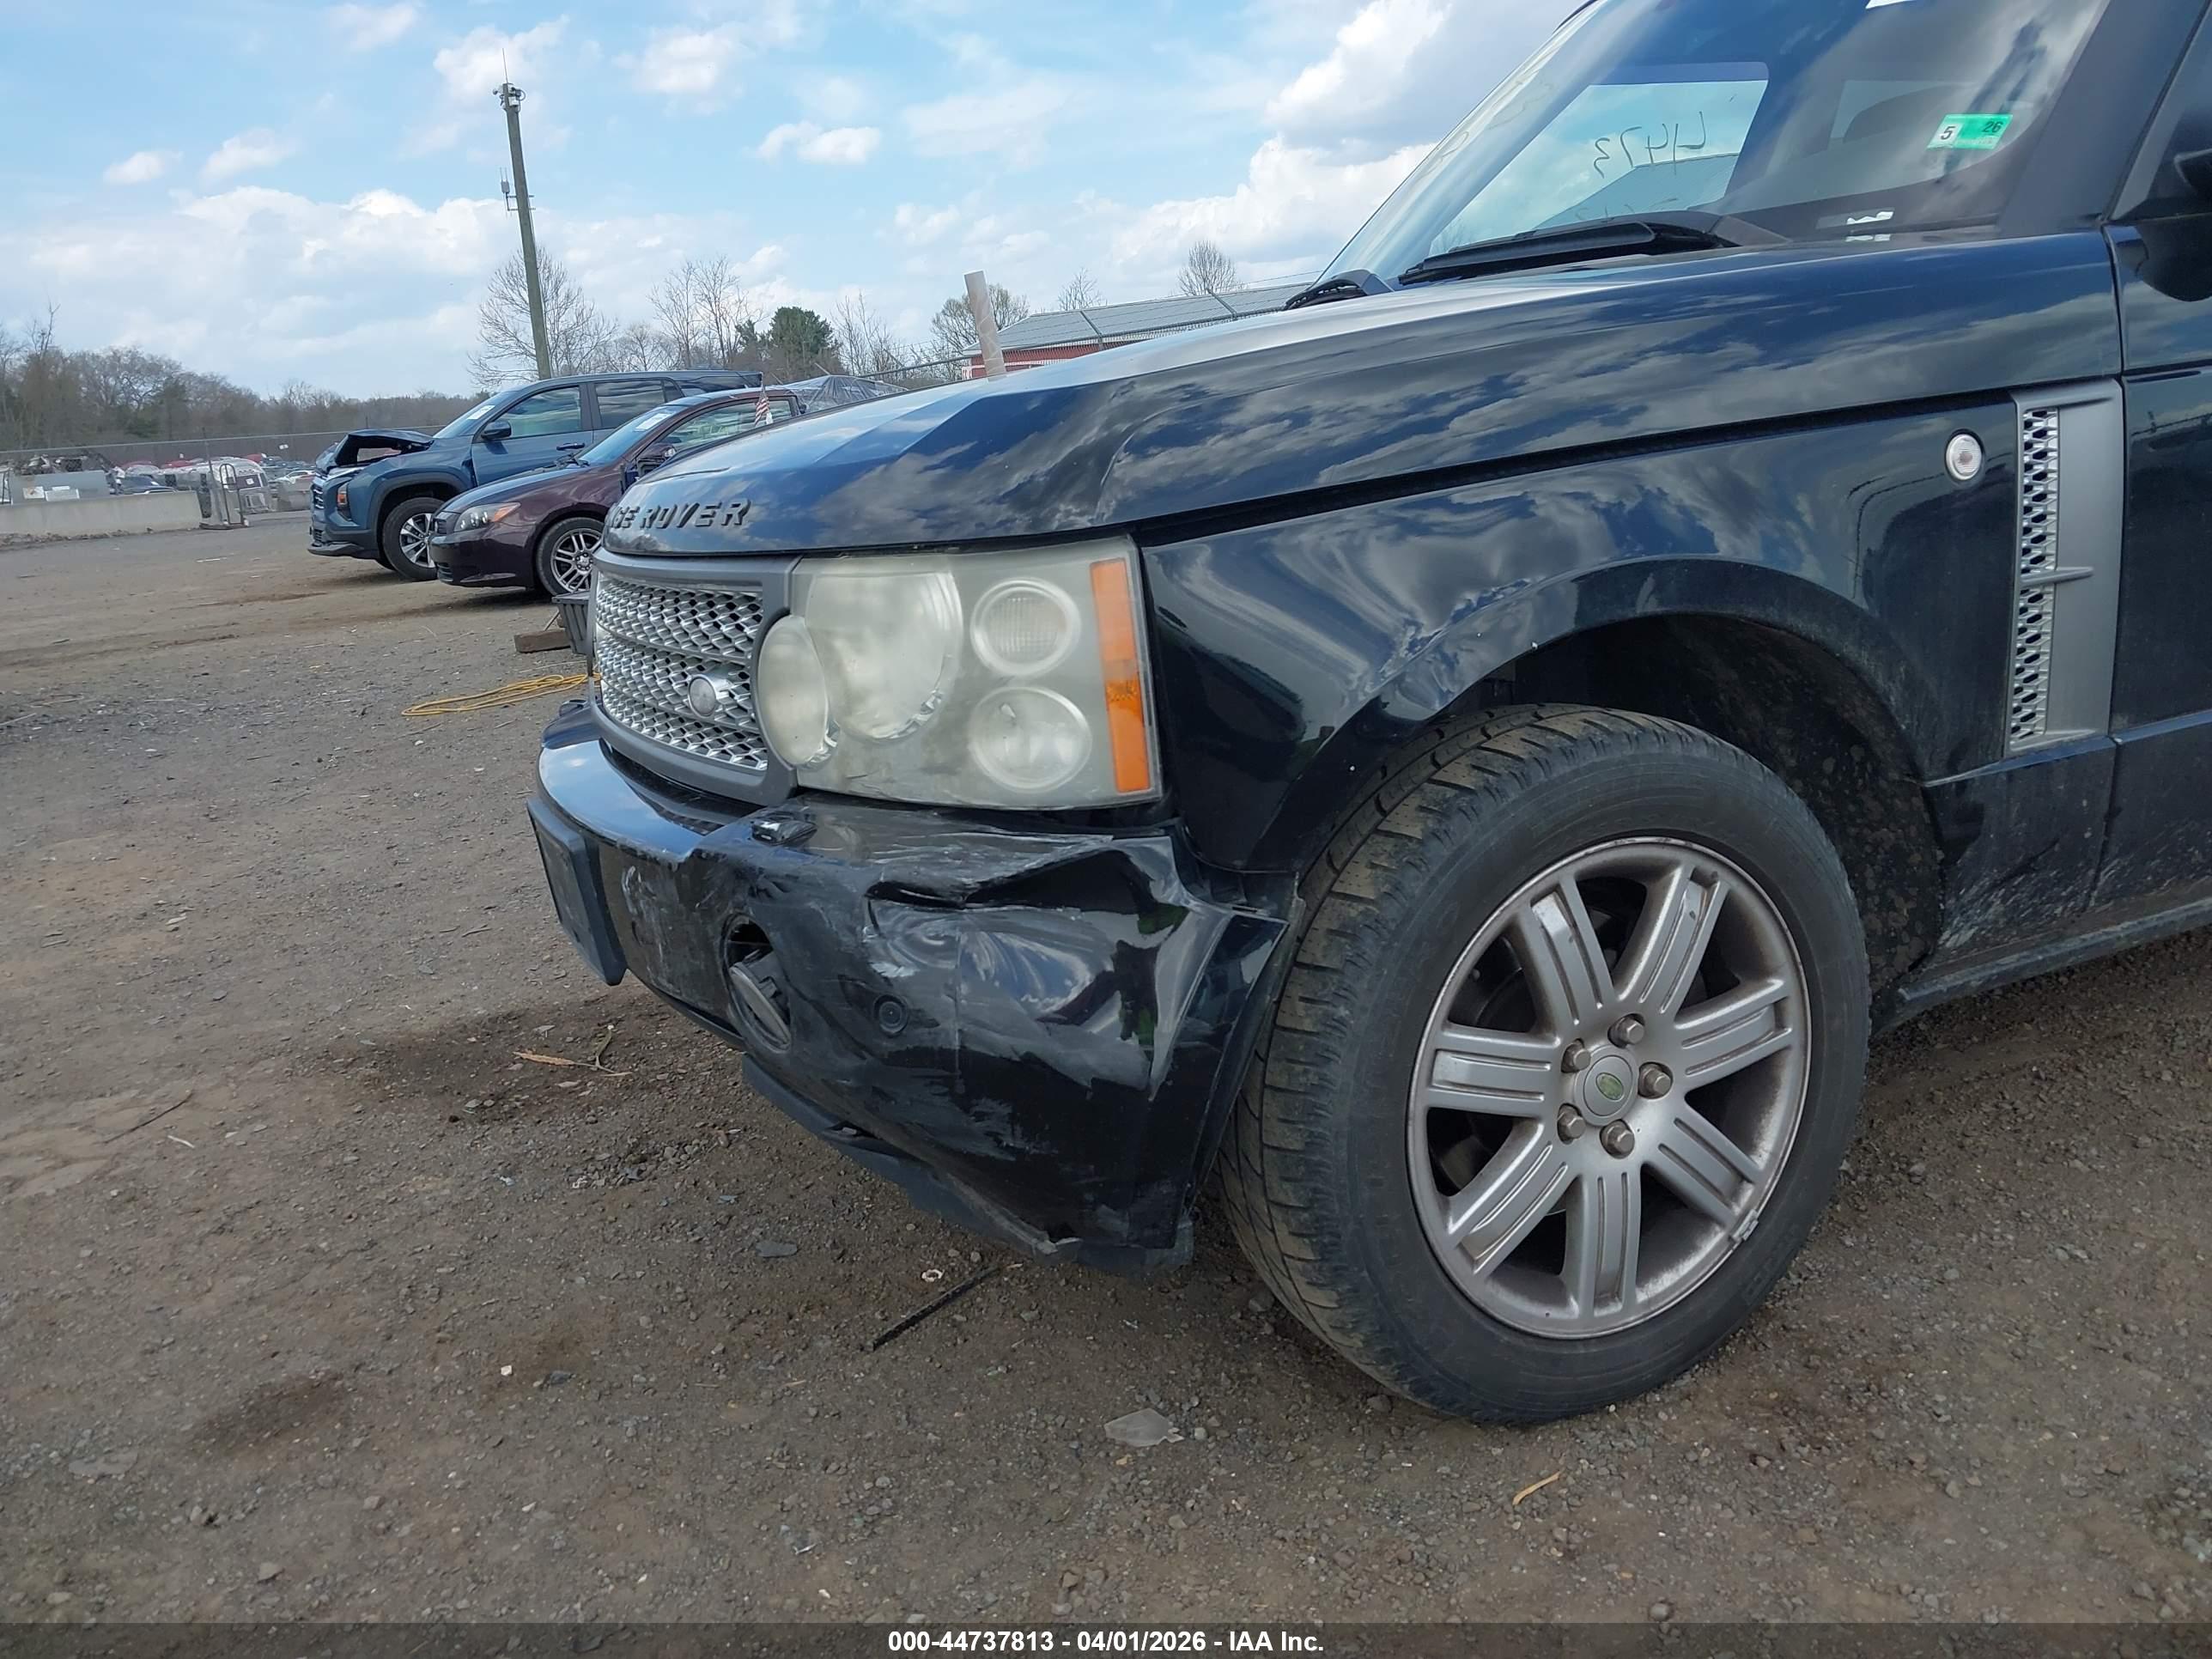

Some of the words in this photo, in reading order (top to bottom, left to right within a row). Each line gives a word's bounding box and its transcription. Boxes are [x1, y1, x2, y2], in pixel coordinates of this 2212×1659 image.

[1941, 125, 1956, 141] 5
[1982, 120, 2004, 134] 26
[640, 497, 751, 530] ROVER
